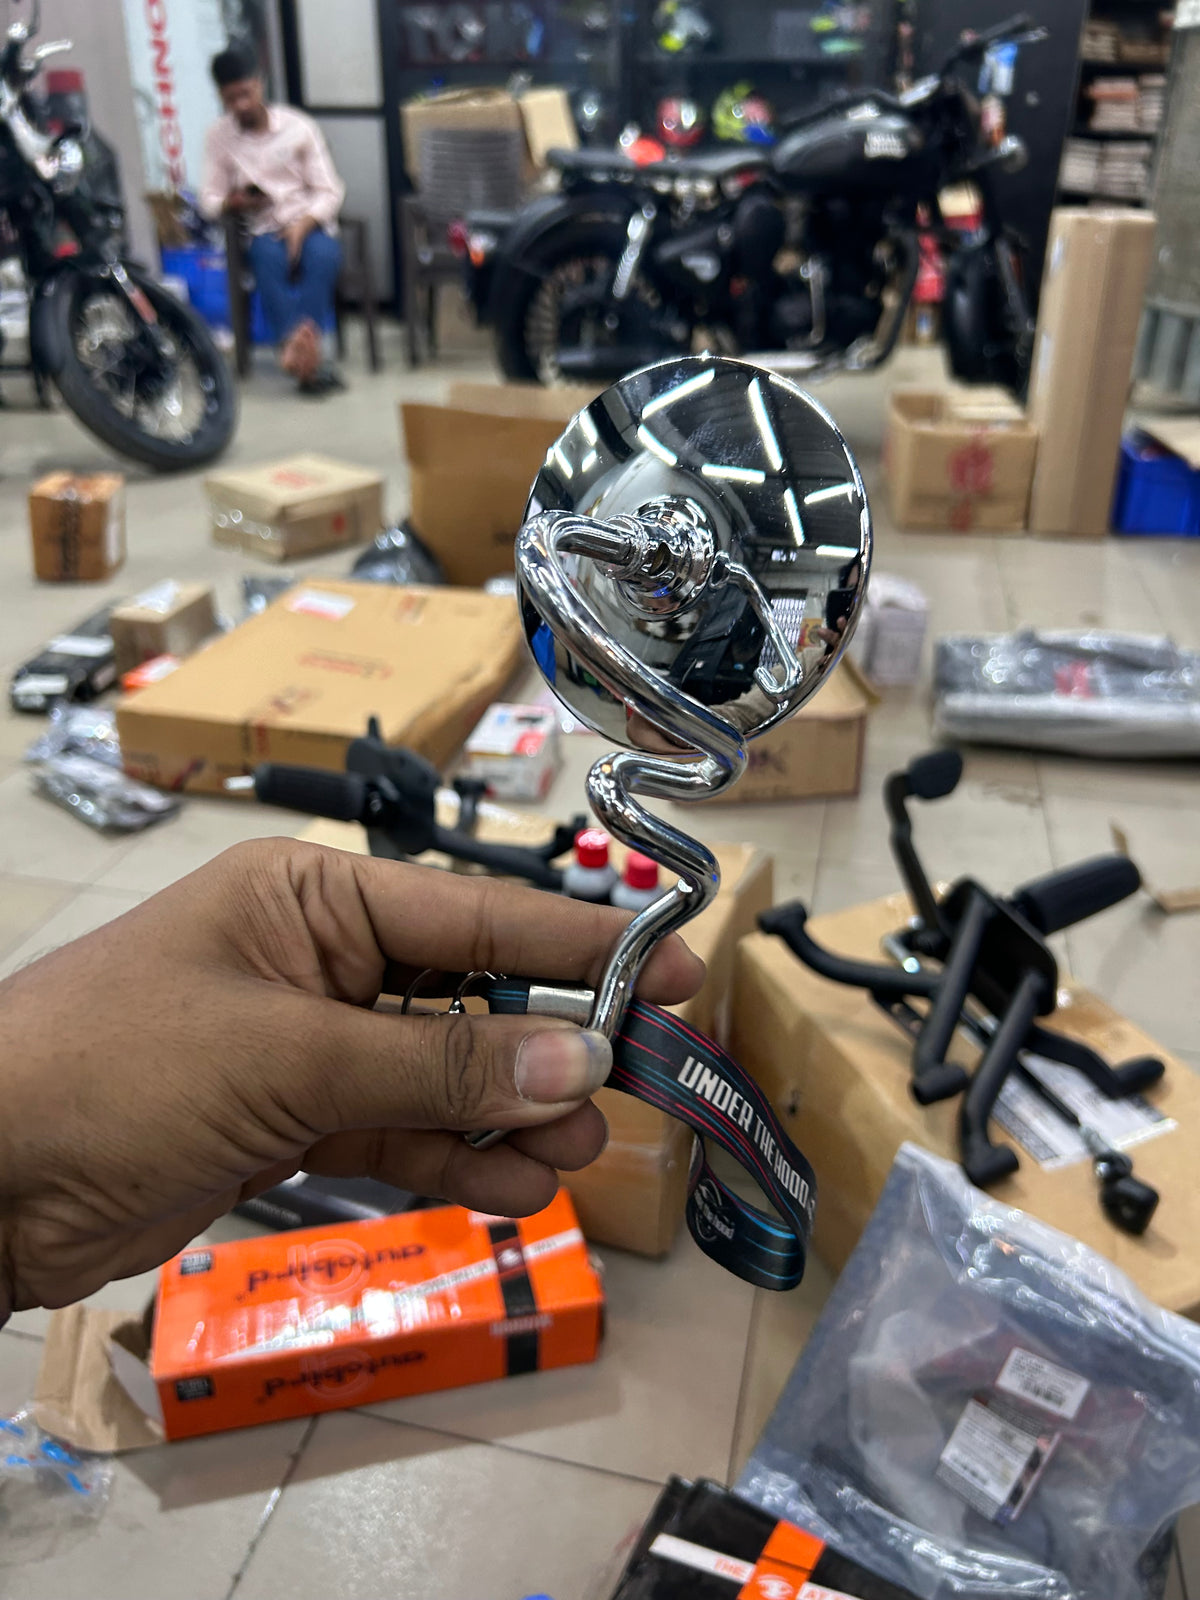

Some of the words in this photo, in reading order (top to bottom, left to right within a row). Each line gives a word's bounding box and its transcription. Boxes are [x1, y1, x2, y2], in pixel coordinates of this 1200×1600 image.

[677, 1055, 754, 1132] UNDER
[753, 1114, 776, 1167] THE
[247, 1242, 427, 1293] autobird
[264, 1348, 427, 1395] autobird
[714, 1557, 746, 1578] THE
